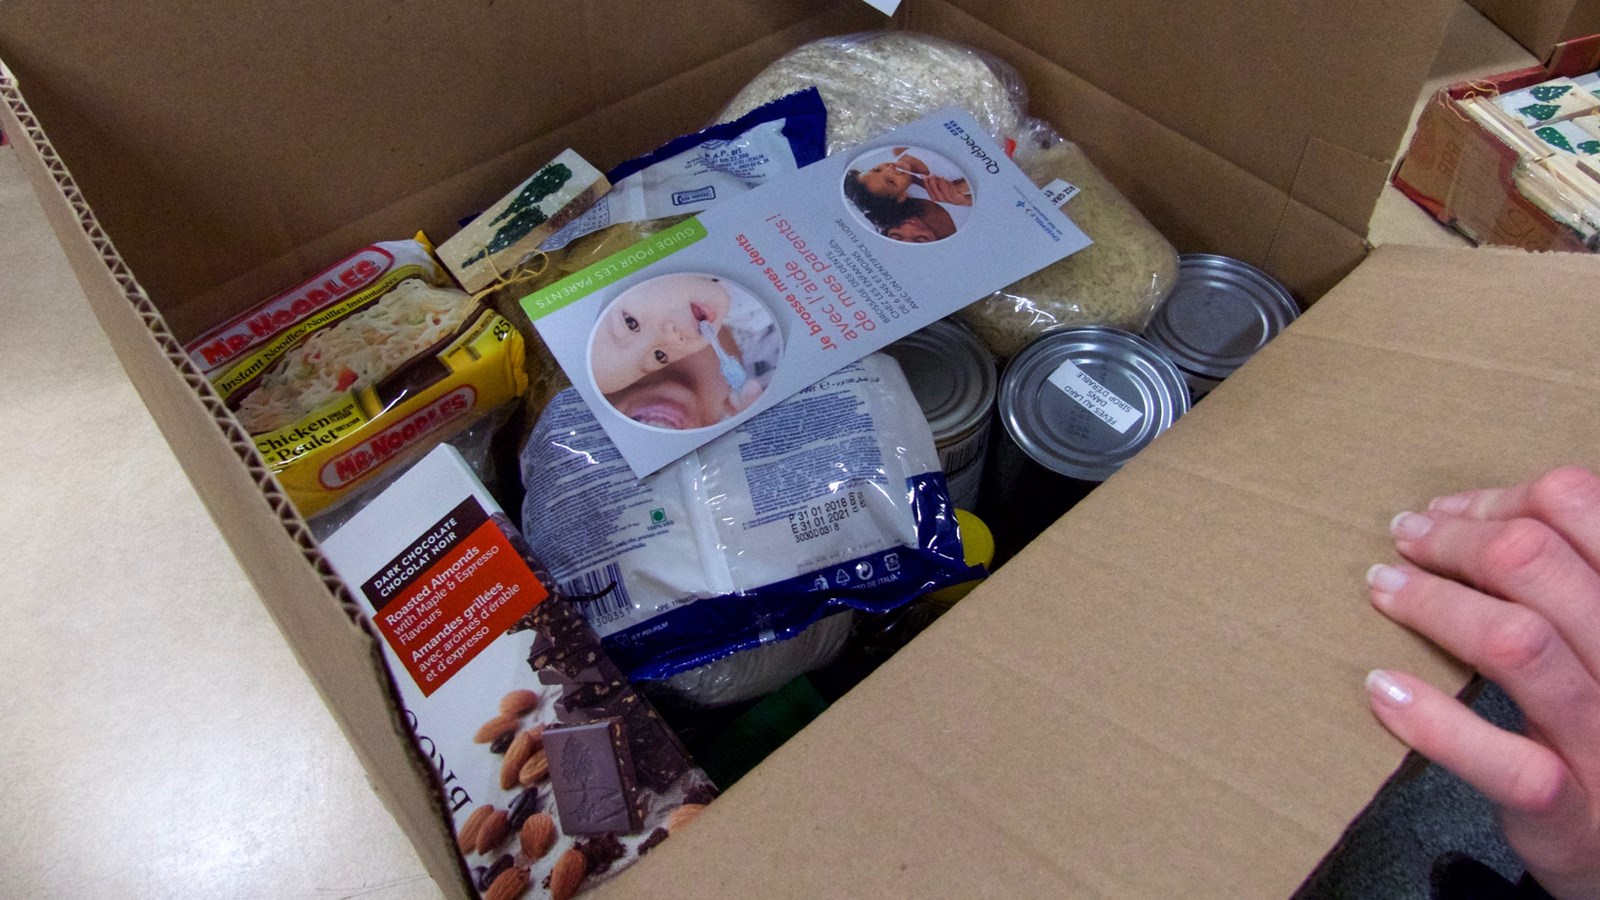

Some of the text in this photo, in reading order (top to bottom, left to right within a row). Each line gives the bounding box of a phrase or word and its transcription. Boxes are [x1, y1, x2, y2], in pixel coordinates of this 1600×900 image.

[960, 134, 1000, 174] Québec
[535, 227, 695, 309] GUIDE POUR LES PARENTS
[844, 257, 873, 288] ENFANTS
[851, 251, 874, 274] MOINS
[857, 243, 893, 281] DENTIFRICE
[871, 274, 882, 284] ET
[247, 259, 381, 337] NOODLES
[735, 233, 838, 351] Je brosse mes dents
[785, 260, 825, 305] l'aide
[823, 274, 856, 309] mes
[826, 251, 891, 324] BROSSAGE DES DENTS
[870, 288, 884, 300] LES
[880, 283, 895, 298] ANS
[890, 280, 903, 292] UN
[900, 291, 920, 310] AVEC
[821, 303, 858, 341] avec
[853, 310, 876, 332] de
[881, 300, 900, 319] CHEZ
[898, 303, 910, 315] DE
[221, 359, 263, 393] Instant
[1064, 385, 1085, 402] LARD
[1083, 399, 1095, 410] AU
[1086, 391, 1108, 407] DANS
[1108, 396, 1132, 413] SIROP
[256, 415, 330, 454] Chicken
[370, 393, 467, 455] NOODLES
[277, 427, 339, 464] Poulet
[788, 513, 796, 523] P
[798, 511, 808, 521] 31
[811, 506, 822, 517] 01
[824, 498, 848, 513] 2018
[791, 523, 799, 534] E
[800, 520, 812, 531] 31
[814, 516, 826, 527] 01
[827, 509, 850, 523] 2021
[374, 517, 458, 590] DARK CHOCOLATE
[380, 532, 458, 598] CHOCOLAT NOIR
[385, 545, 480, 626] Roasted Almonds
[393, 545, 499, 636] with Maple & Espresso
[399, 608, 443, 645] Flavours
[411, 581, 504, 663] Amandes grillées
[419, 649, 444, 673] avec
[480, 583, 521, 620] d'érable
[425, 626, 490, 683] et d'expresso
